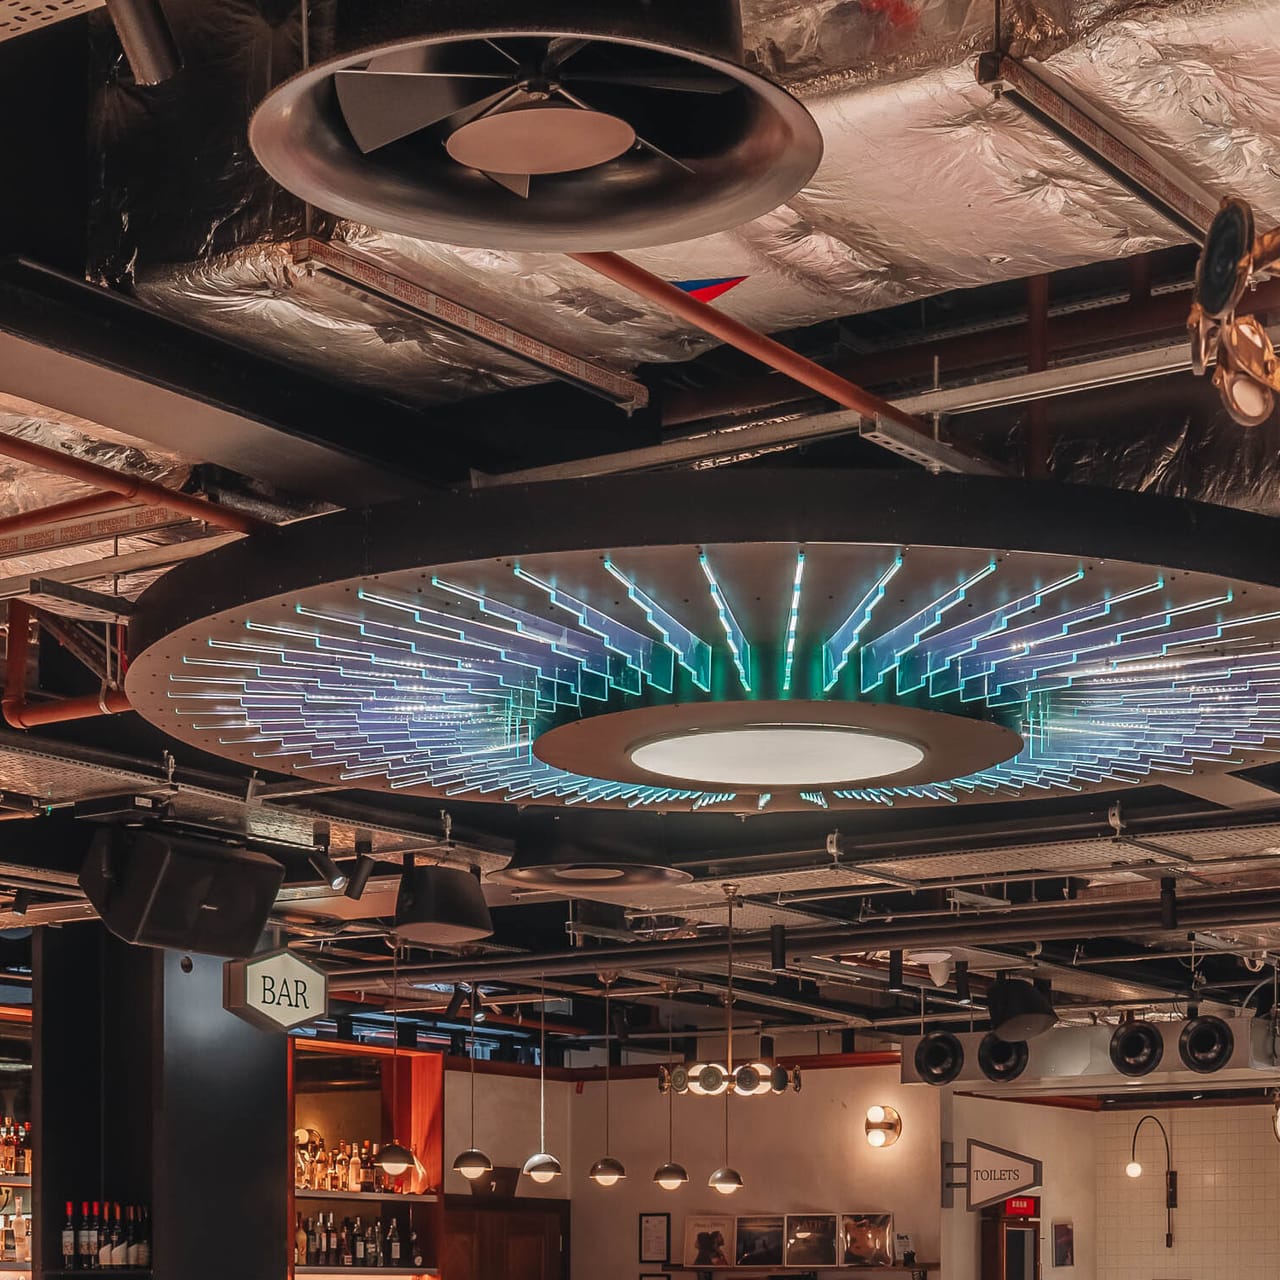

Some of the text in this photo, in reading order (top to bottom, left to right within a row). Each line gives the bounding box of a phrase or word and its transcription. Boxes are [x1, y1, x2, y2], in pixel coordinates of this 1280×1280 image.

[394, 279, 429, 303] FIREDUCT
[435, 297, 469, 319] FIREDUCT
[475, 315, 507, 336] FIREDUCT
[136, 507, 168, 520] FIREDUCT
[261, 975, 310, 1009] BAR
[973, 1169, 1020, 1181] TOILETS
